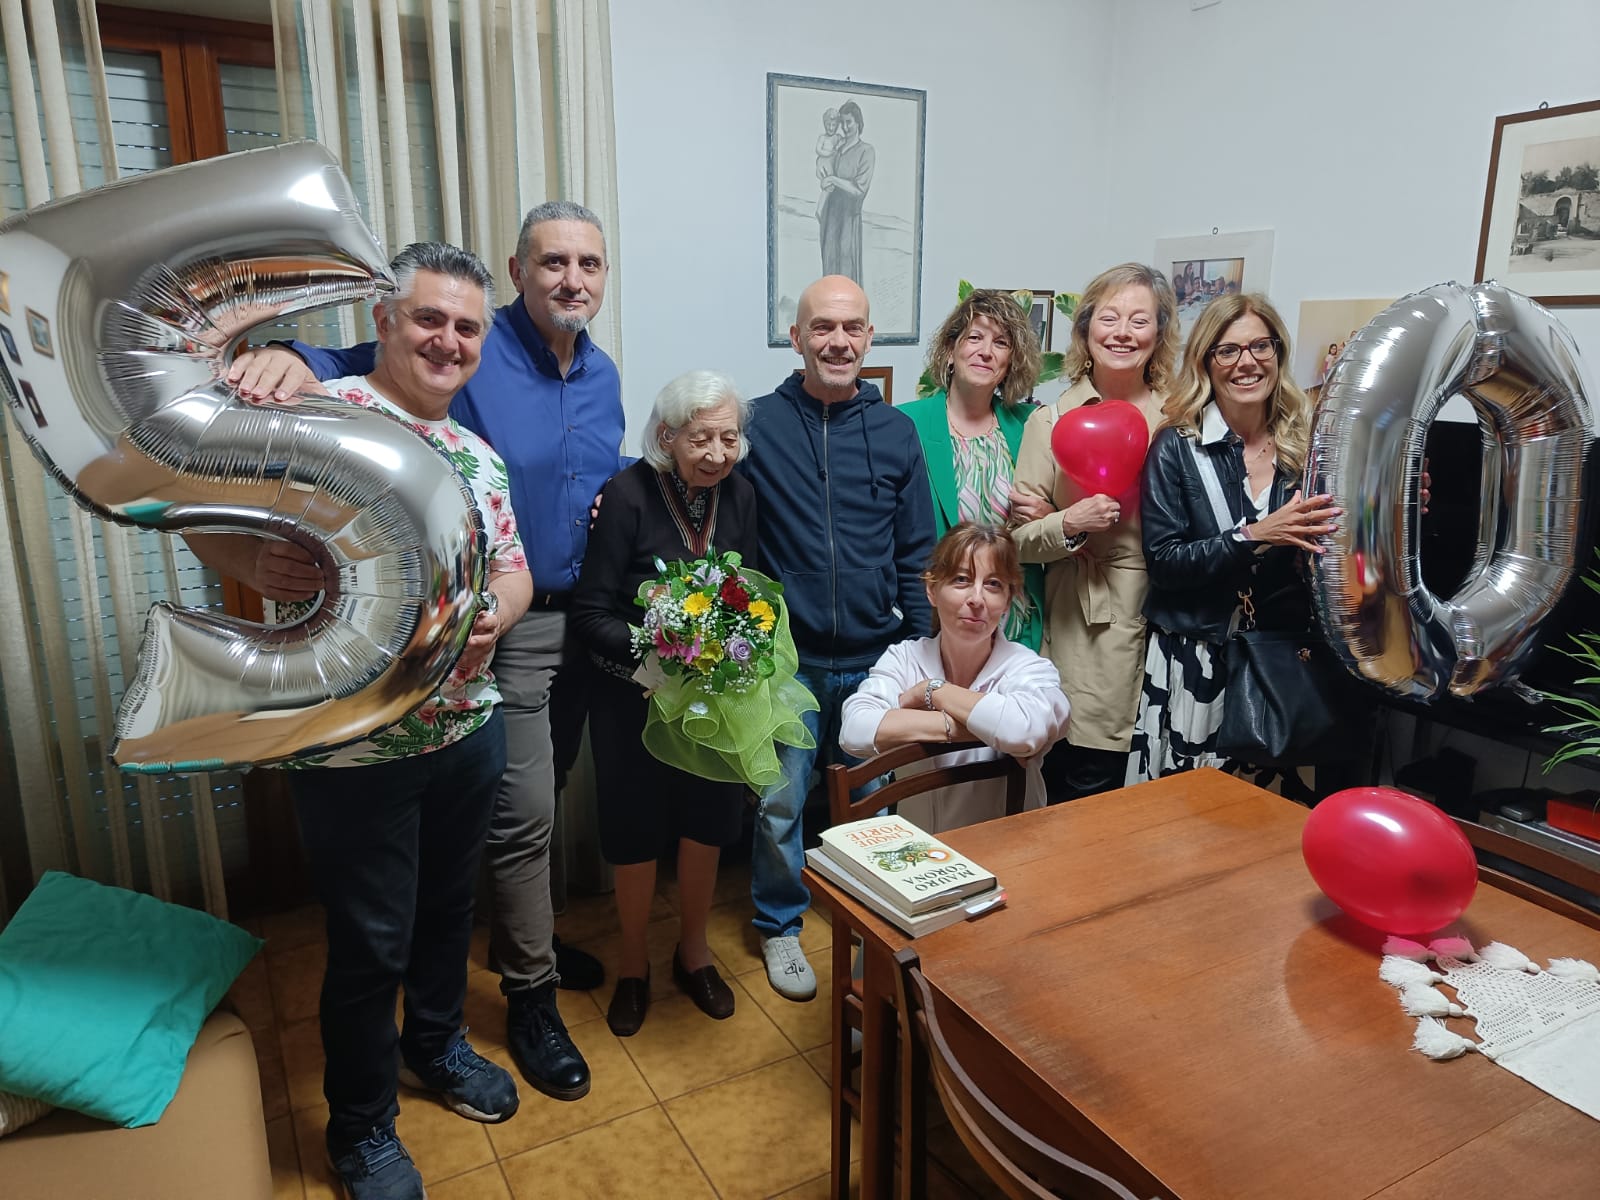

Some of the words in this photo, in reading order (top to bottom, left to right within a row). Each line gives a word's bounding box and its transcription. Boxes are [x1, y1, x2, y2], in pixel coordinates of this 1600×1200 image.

[0, 139, 488, 774] 5
[1304, 280, 1594, 703] 0
[845, 824, 903, 841] PORTE
[856, 829, 914, 848] CINQUE
[902, 863, 967, 884] CORONA
[914, 869, 976, 891] MAURO
